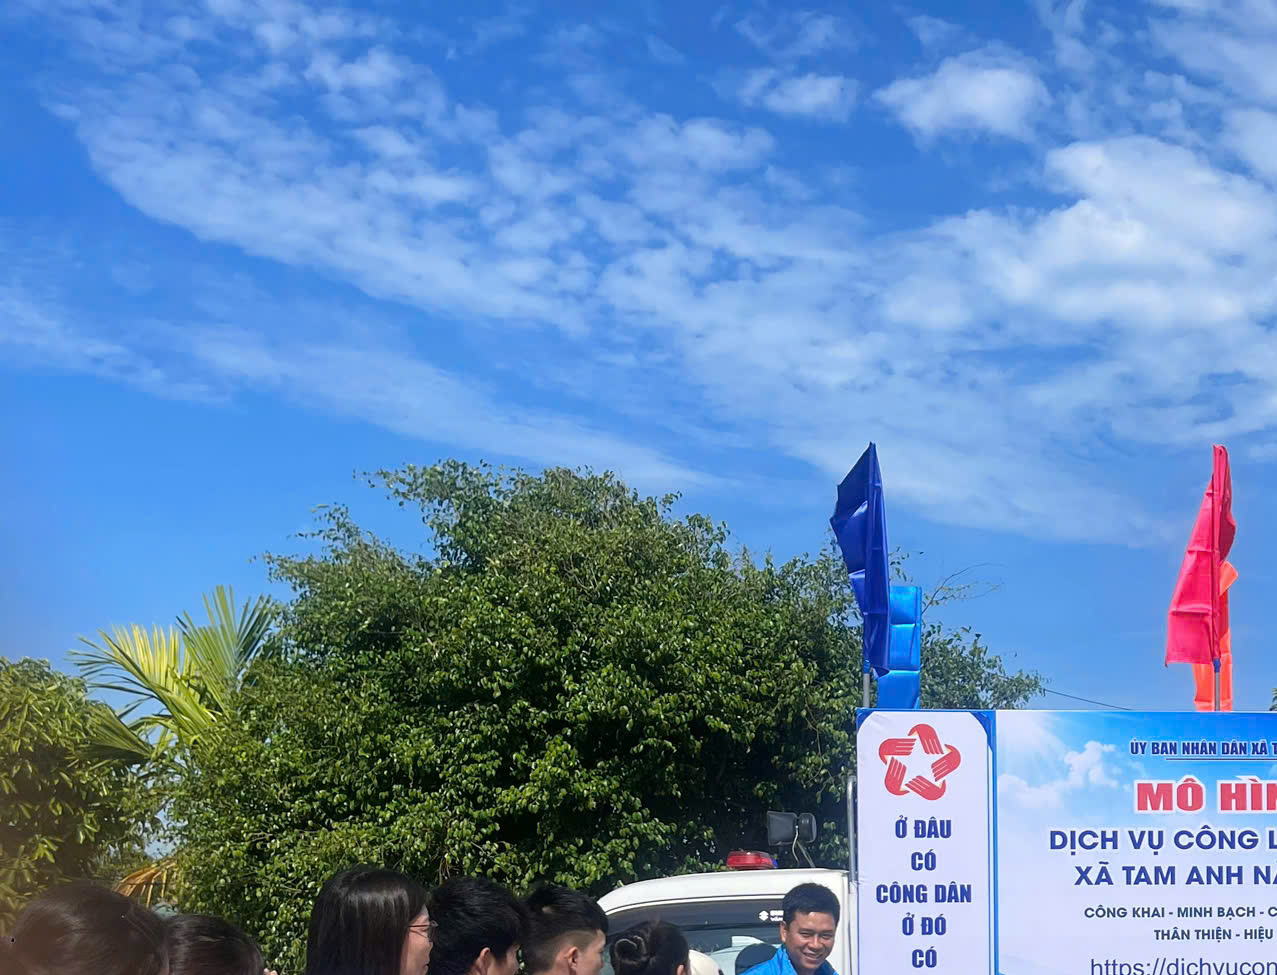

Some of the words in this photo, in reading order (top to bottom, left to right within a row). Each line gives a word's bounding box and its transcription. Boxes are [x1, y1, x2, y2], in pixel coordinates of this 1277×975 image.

[1130, 739, 1147, 755] ỦY
[1152, 742, 1177, 755] BAN
[1182, 740, 1217, 755] NHÂN
[1222, 740, 1247, 755] DÂN
[1251, 740, 1268, 755] XÃ
[1136, 777, 1204, 811] MÔ
[896, 815, 907, 838] Ở
[914, 817, 951, 838] ĐÂU
[1050, 831, 1118, 855] DỊCH
[1128, 831, 1163, 855] VỤ
[1174, 825, 1258, 849] CÔNG
[911, 849, 936, 870] CÓ
[1074, 861, 1113, 885] XÃ
[1122, 866, 1175, 885] TAM
[1186, 866, 1243, 884] ANH
[876, 882, 927, 903] CÔNG
[935, 881, 971, 902] DÂN
[902, 912, 914, 935] Ở
[921, 914, 946, 935] ĐÓ
[1085, 905, 1127, 918] CÔNG
[1133, 907, 1164, 917] KHAI
[1178, 907, 1212, 917] MINH
[1218, 907, 1255, 920] BẠCH
[1154, 927, 1190, 940] THÂN
[1195, 927, 1231, 942] THIỆN
[1245, 926, 1273, 942] HIỆU
[912, 946, 937, 968] CÓ
